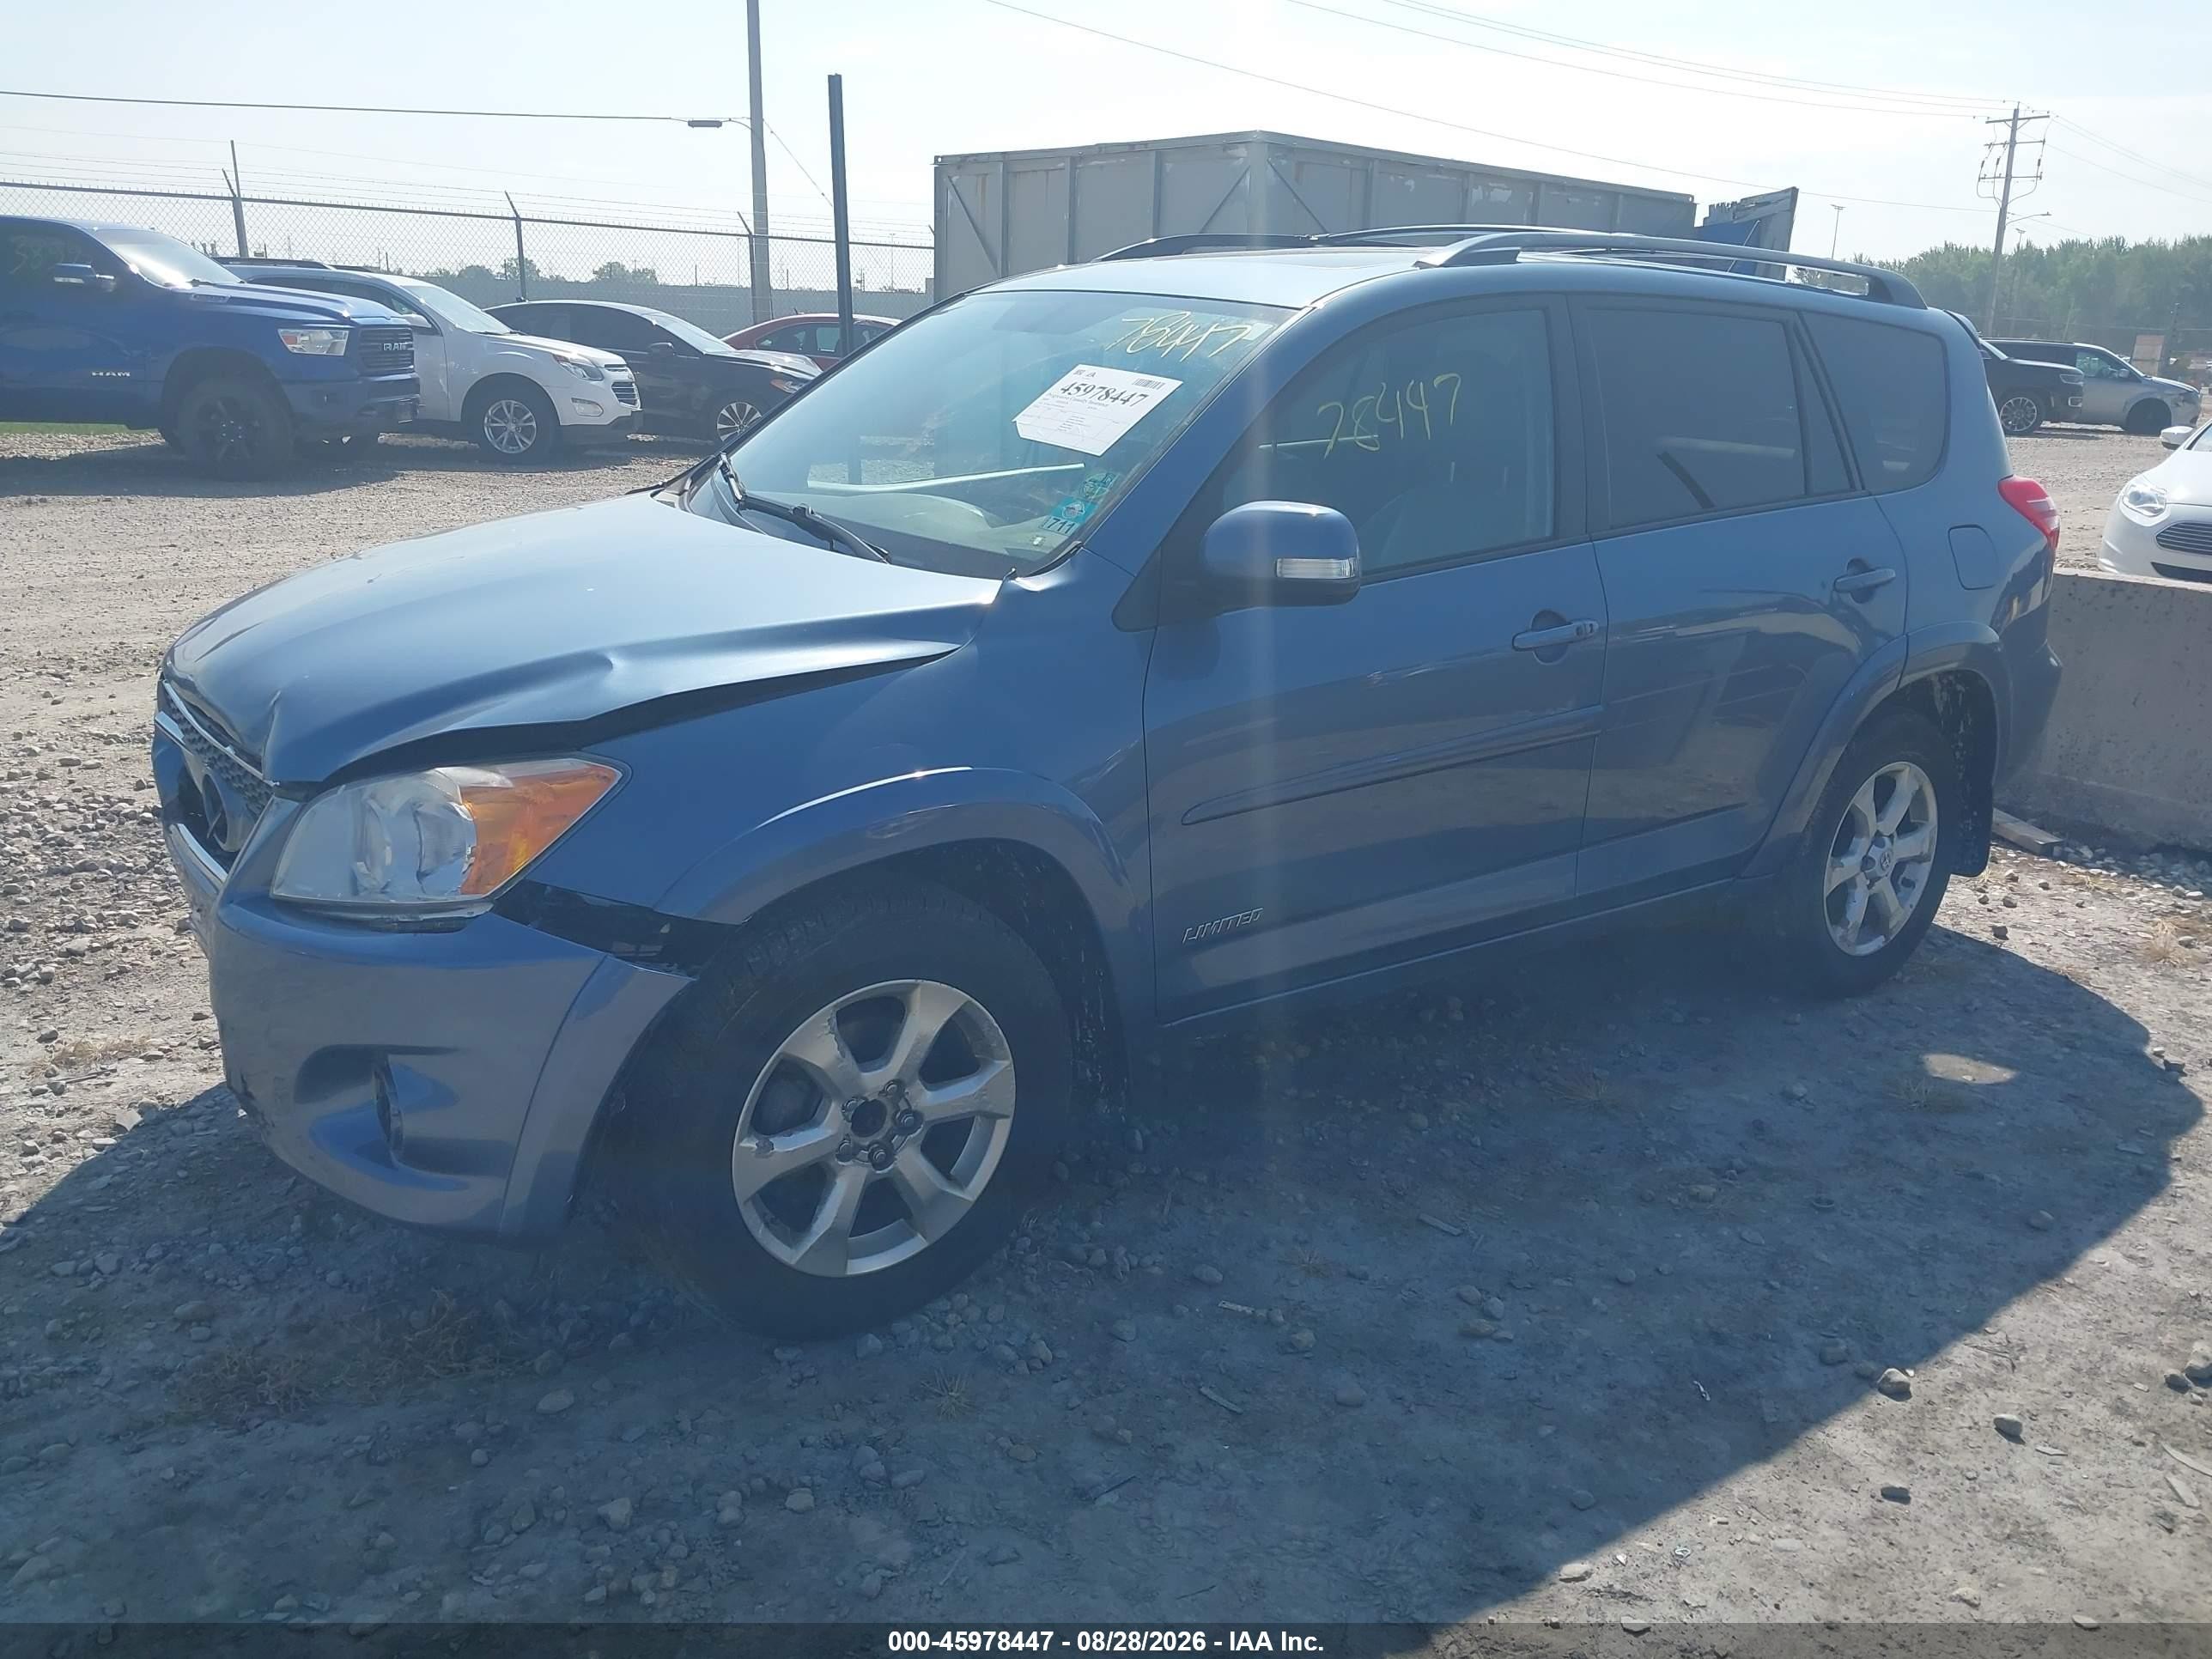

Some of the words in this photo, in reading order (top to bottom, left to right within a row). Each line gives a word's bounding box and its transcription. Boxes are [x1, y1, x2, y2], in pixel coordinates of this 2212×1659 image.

[1060, 381, 1149, 407] 45978447
[1317, 373, 1462, 459] 78447
[1182, 907, 1263, 944] LIMITED
